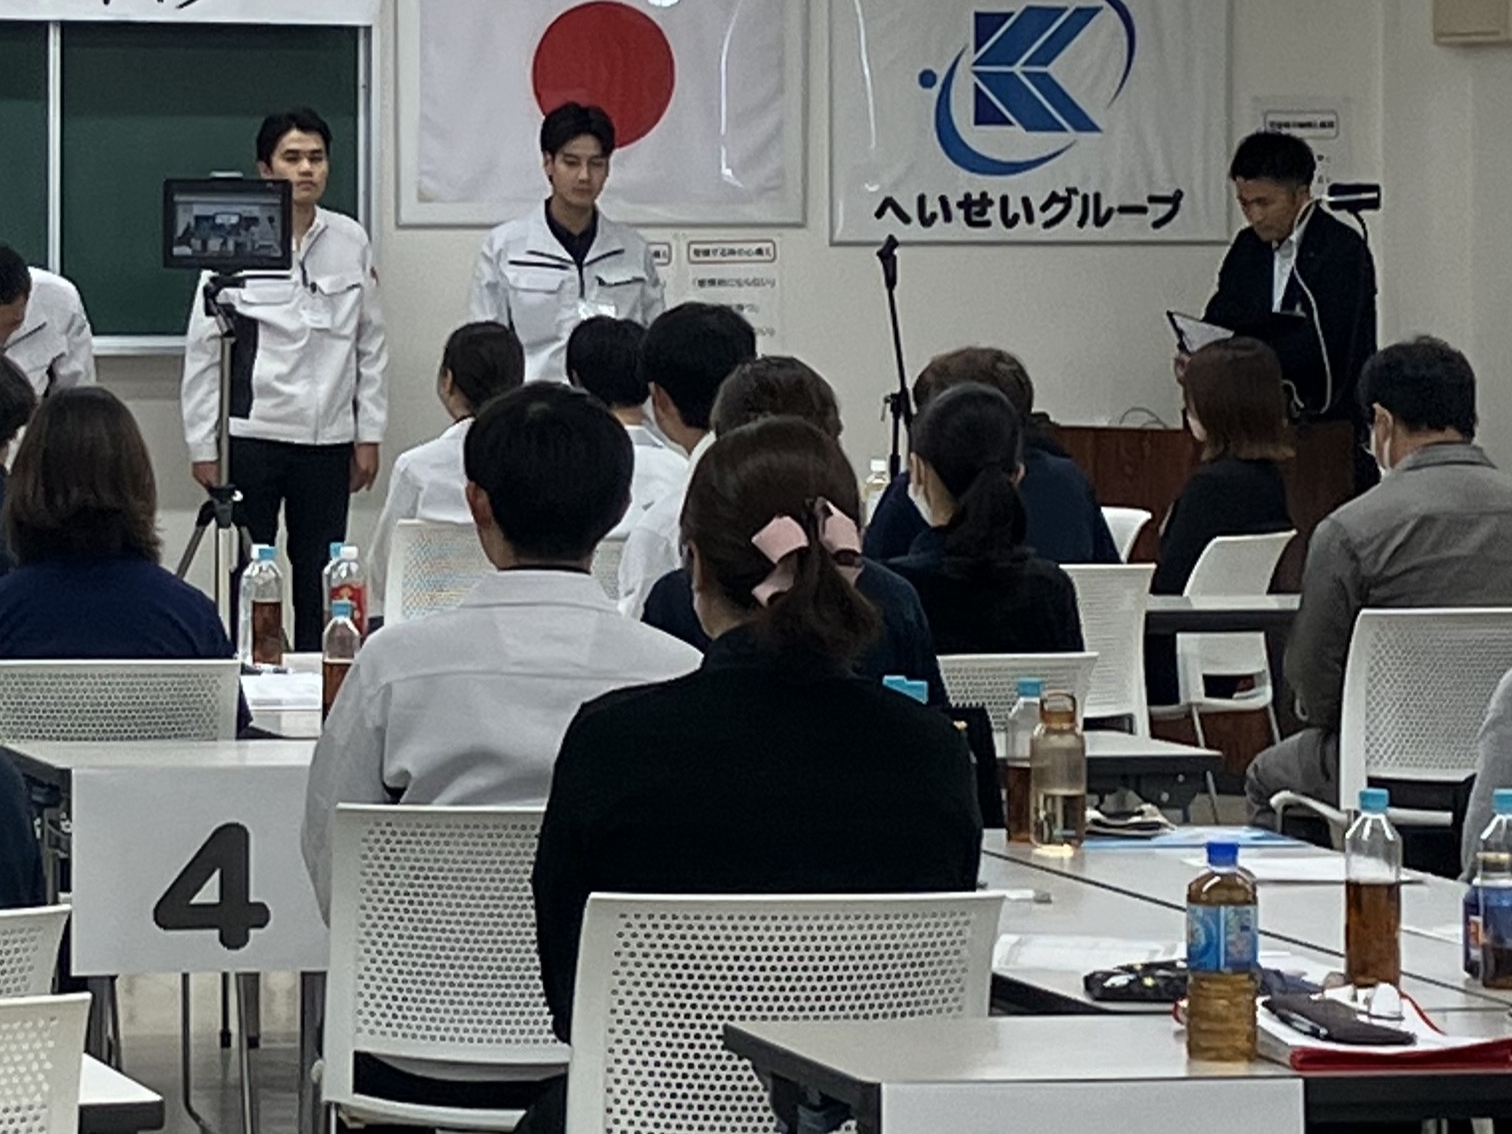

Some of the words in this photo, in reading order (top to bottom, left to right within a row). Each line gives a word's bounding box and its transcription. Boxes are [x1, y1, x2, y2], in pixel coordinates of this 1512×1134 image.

[873, 186, 1185, 230] へいせいグループ
[153, 822, 271, 951] 4
